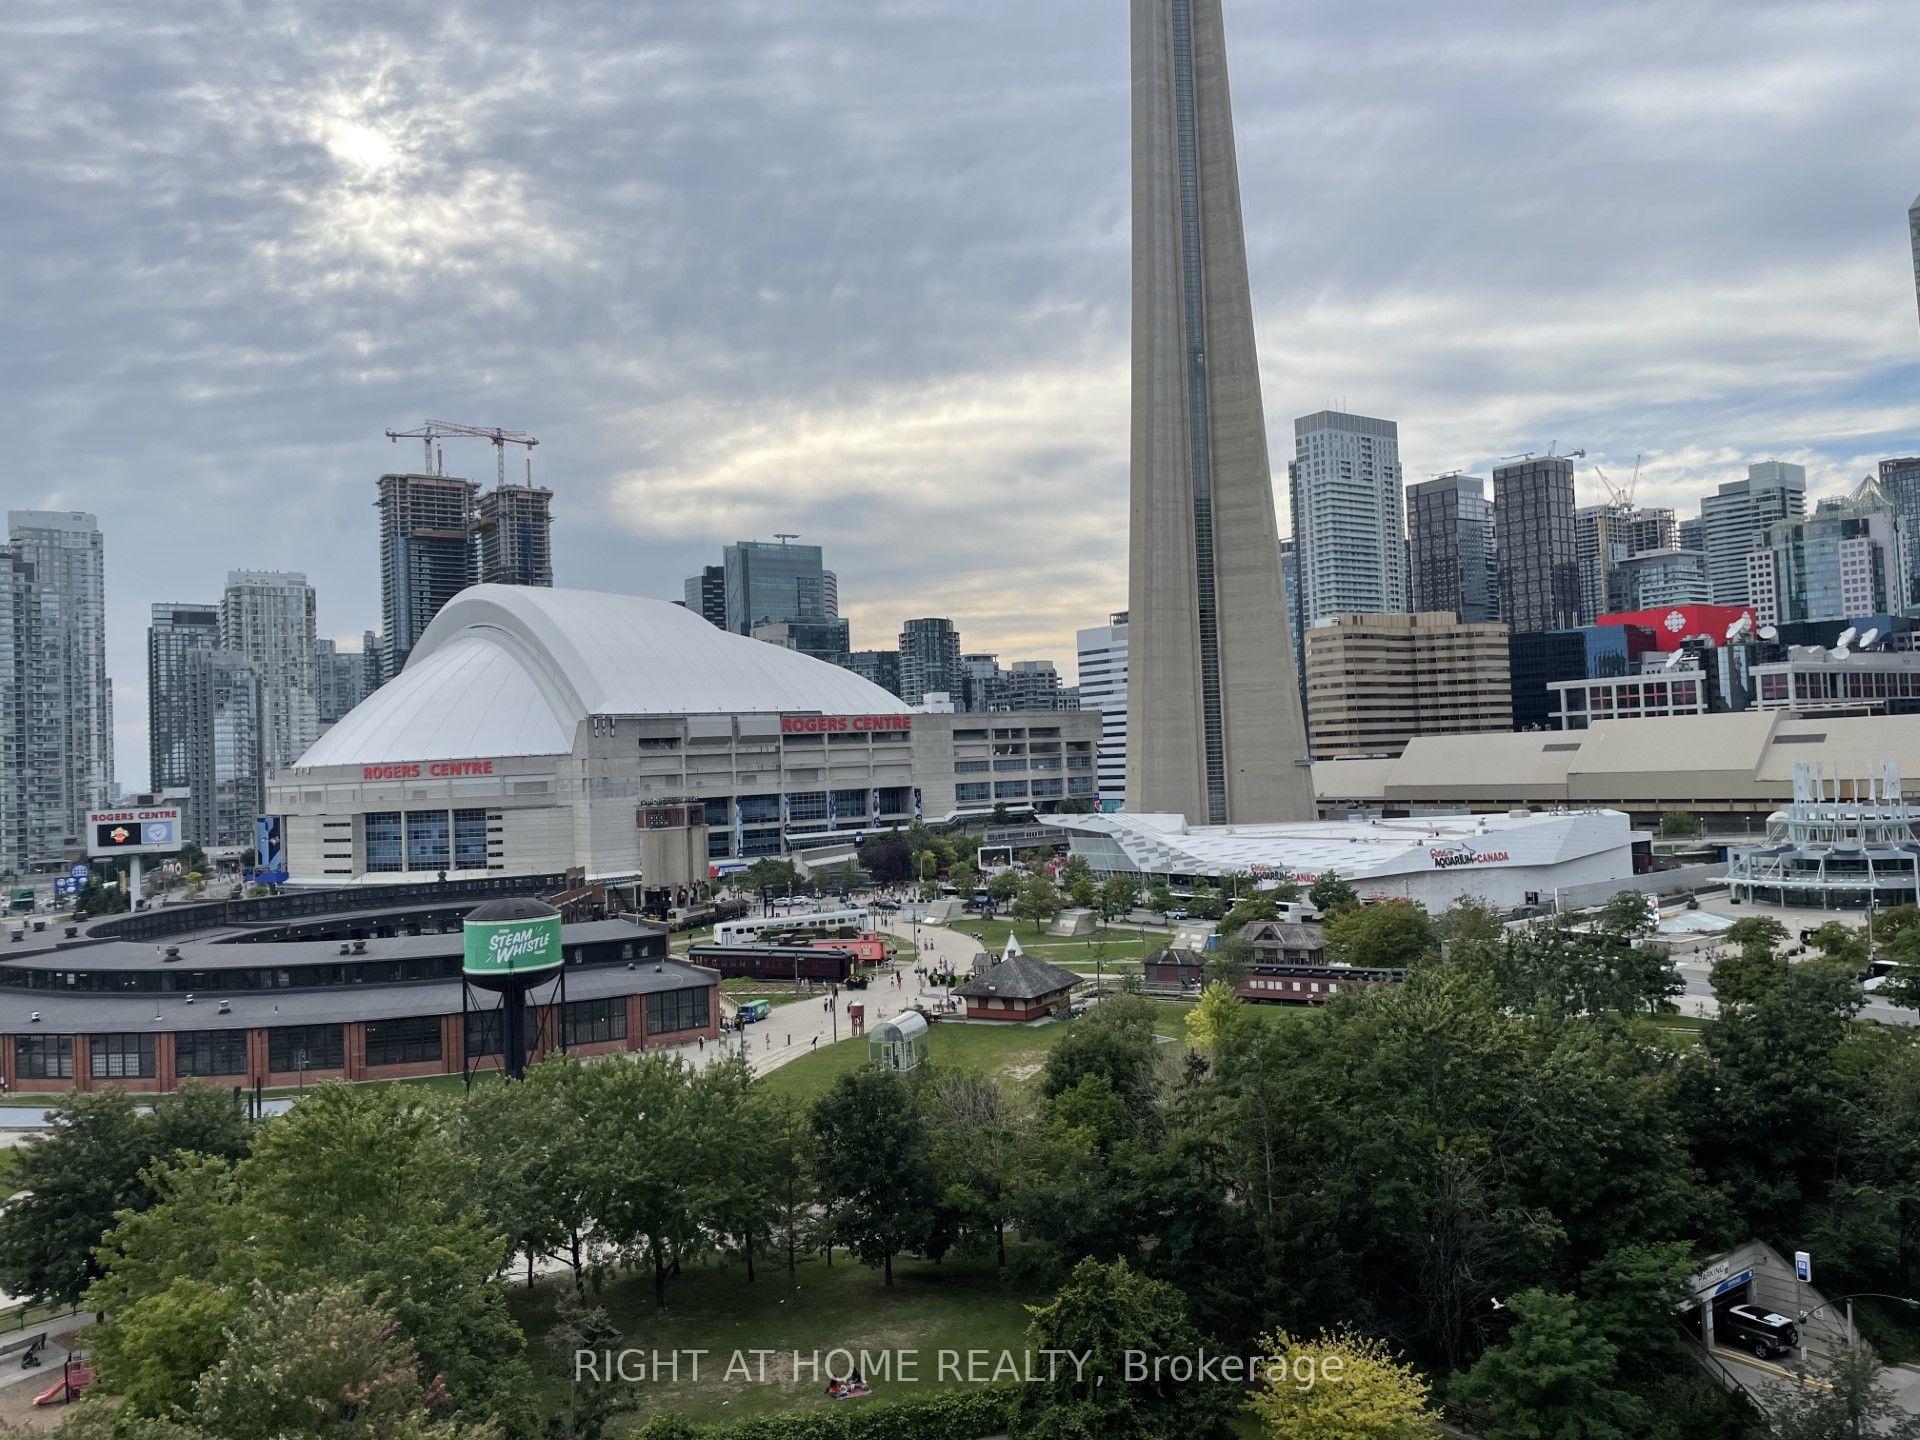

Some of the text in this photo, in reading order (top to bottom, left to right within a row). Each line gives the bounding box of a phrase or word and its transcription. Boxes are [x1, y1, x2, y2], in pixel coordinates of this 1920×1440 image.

[782, 716, 911, 732] ROGERS CENTRE
[363, 761, 492, 779] ROGERS CENTRE
[91, 811, 177, 821] ROGERS CENTRE
[1477, 851, 1509, 863] CANADA
[489, 928, 533, 951] STEAM
[496, 933, 550, 964] WHISTLE
